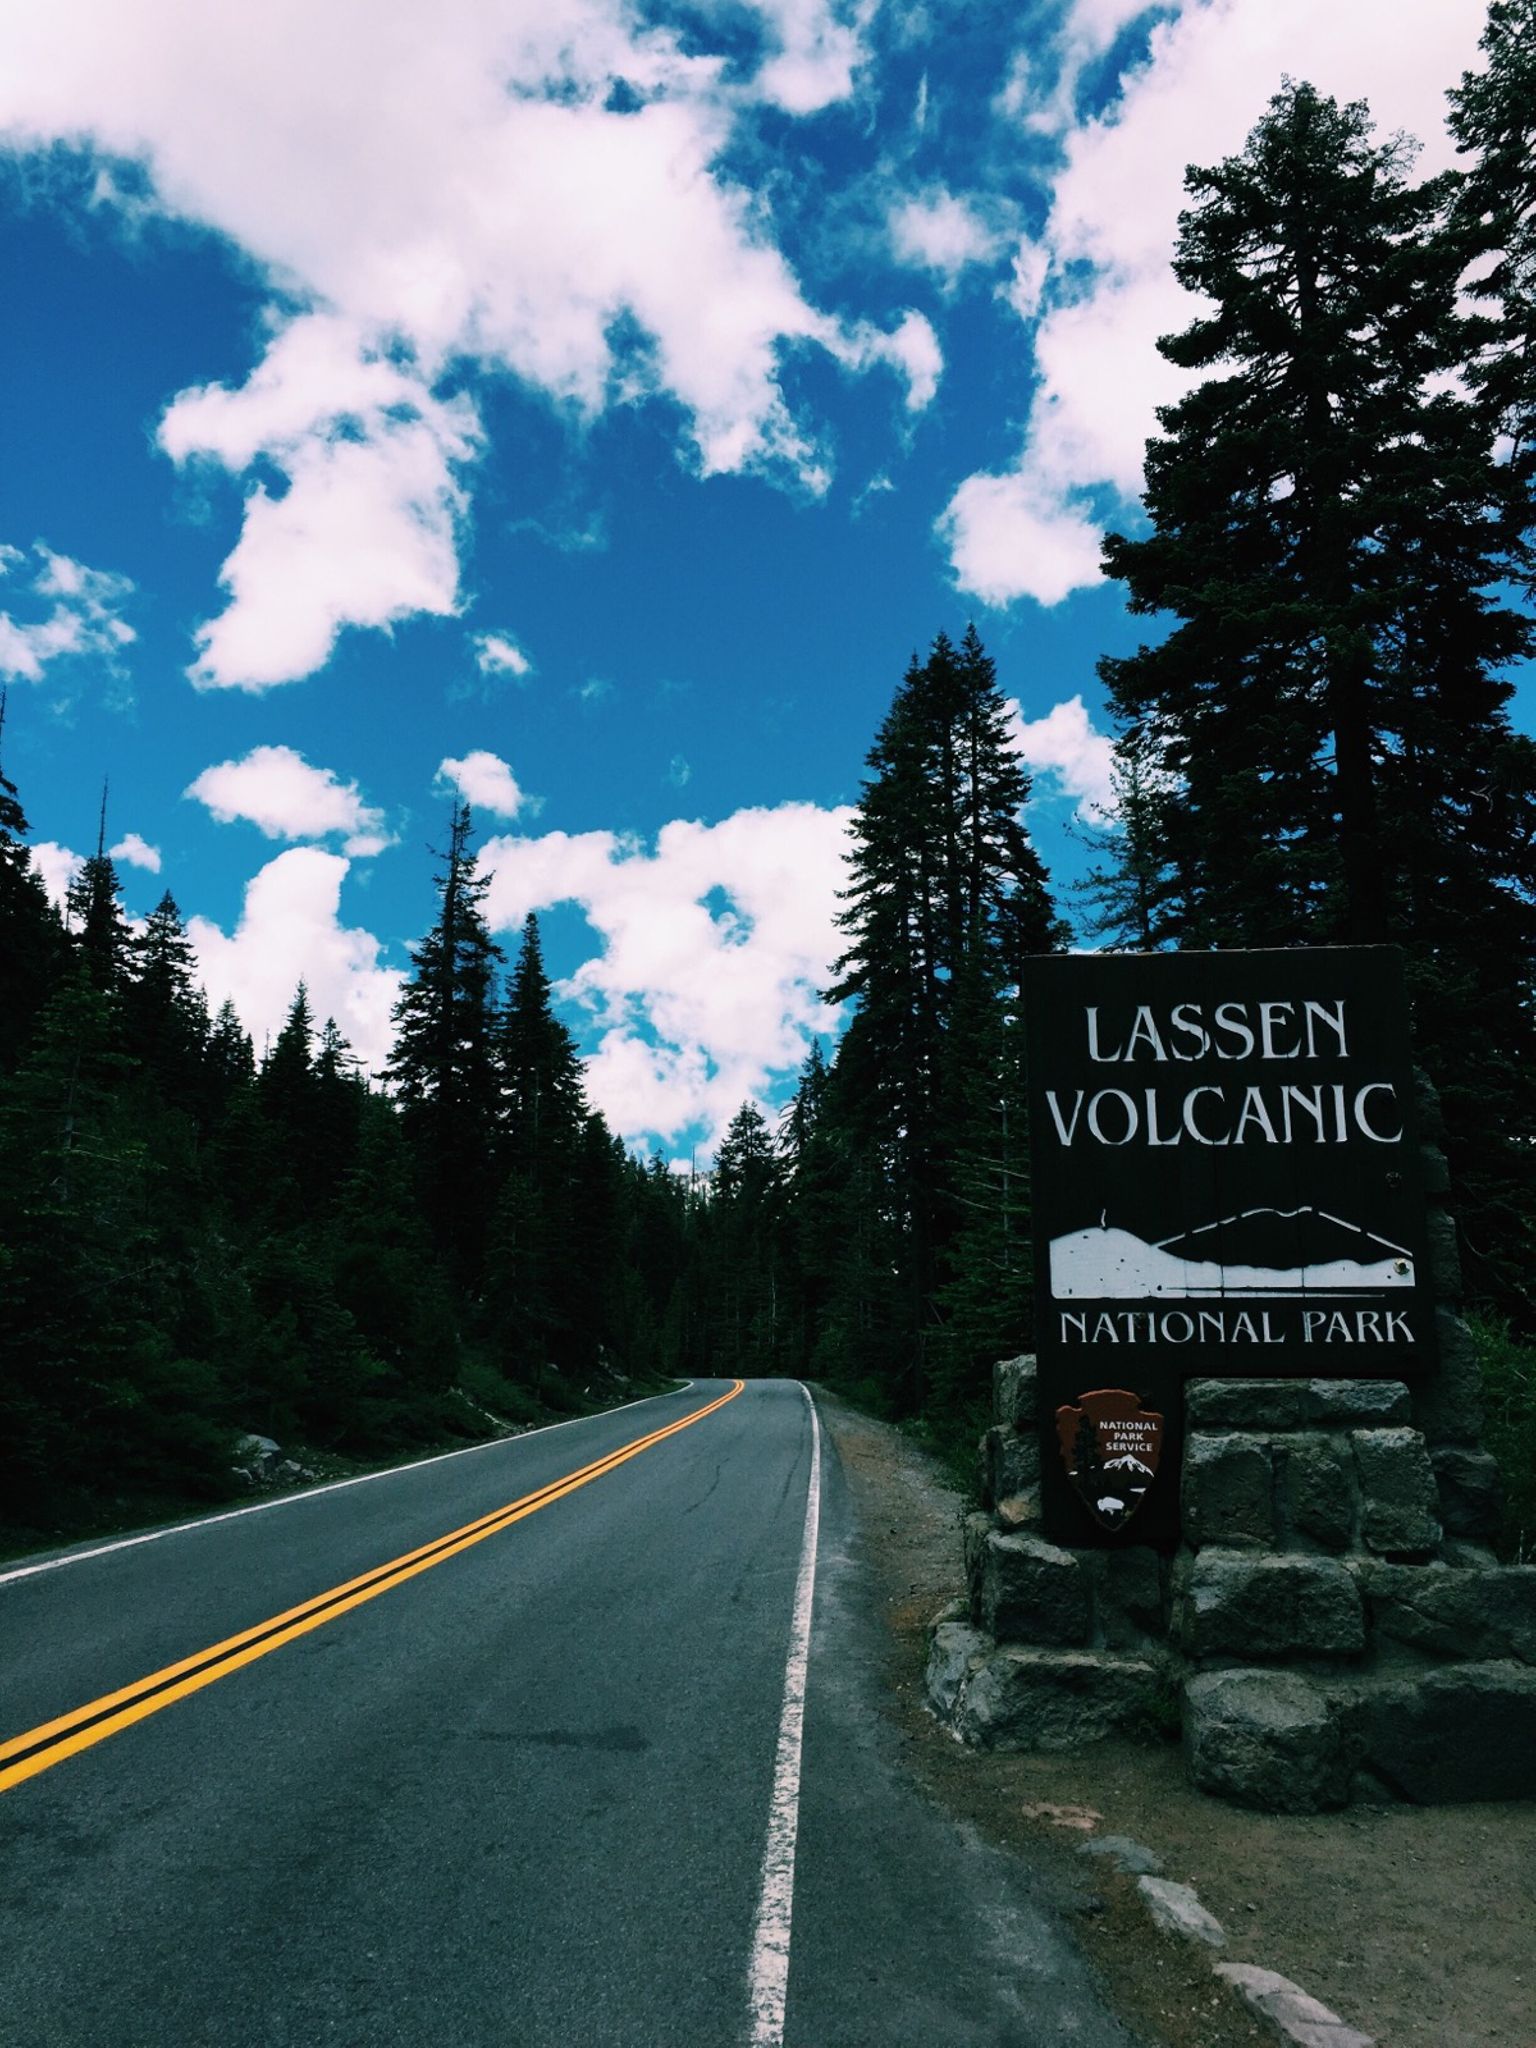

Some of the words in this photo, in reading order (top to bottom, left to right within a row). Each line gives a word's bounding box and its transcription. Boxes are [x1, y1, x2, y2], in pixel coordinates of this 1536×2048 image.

[1087, 1001, 1349, 1062] LASSEN
[1046, 1084, 1403, 1147] VOLCANIC
[1059, 1312, 1286, 1344] NATIONAL
[1303, 1311, 1416, 1343] PARK
[1099, 1420, 1158, 1431] NATIONAL
[1113, 1432, 1144, 1441] PARK
[1105, 1442, 1154, 1452] SERVICE
